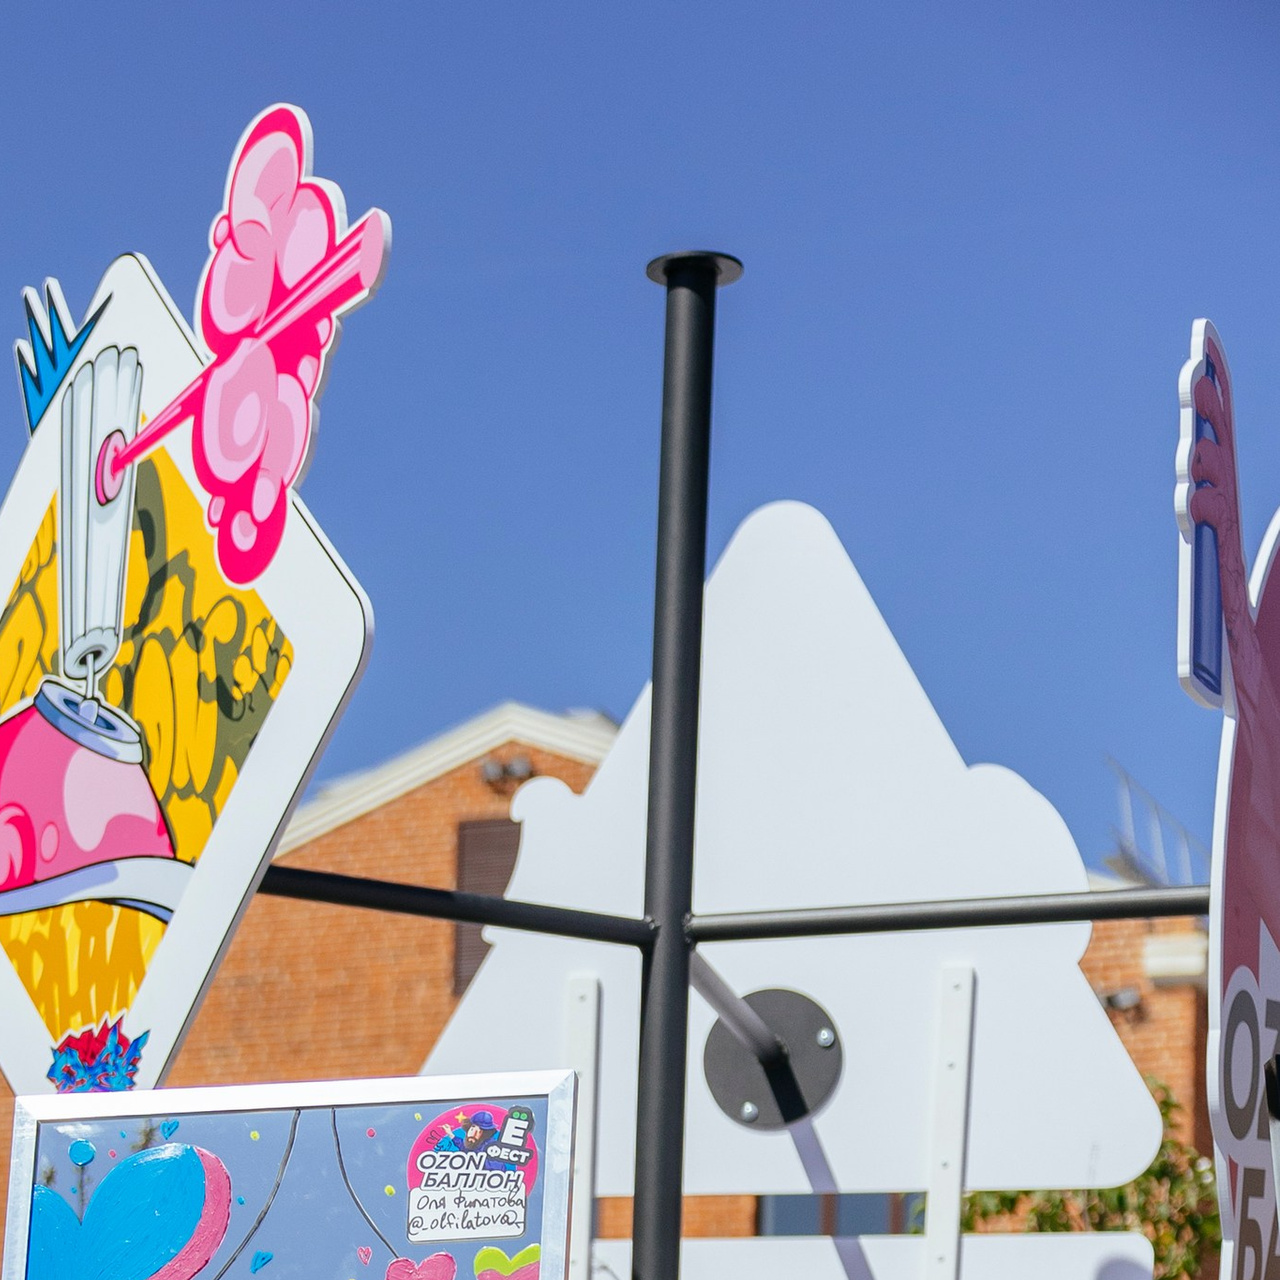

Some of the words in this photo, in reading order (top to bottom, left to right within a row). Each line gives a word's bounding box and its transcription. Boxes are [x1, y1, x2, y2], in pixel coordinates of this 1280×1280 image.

[419, 1153, 485, 1171] OZON
[487, 1145, 530, 1163] ФЕСТ
[423, 1172, 522, 1190] БАЛЛОН
[416, 1195, 446, 1210] Оля
